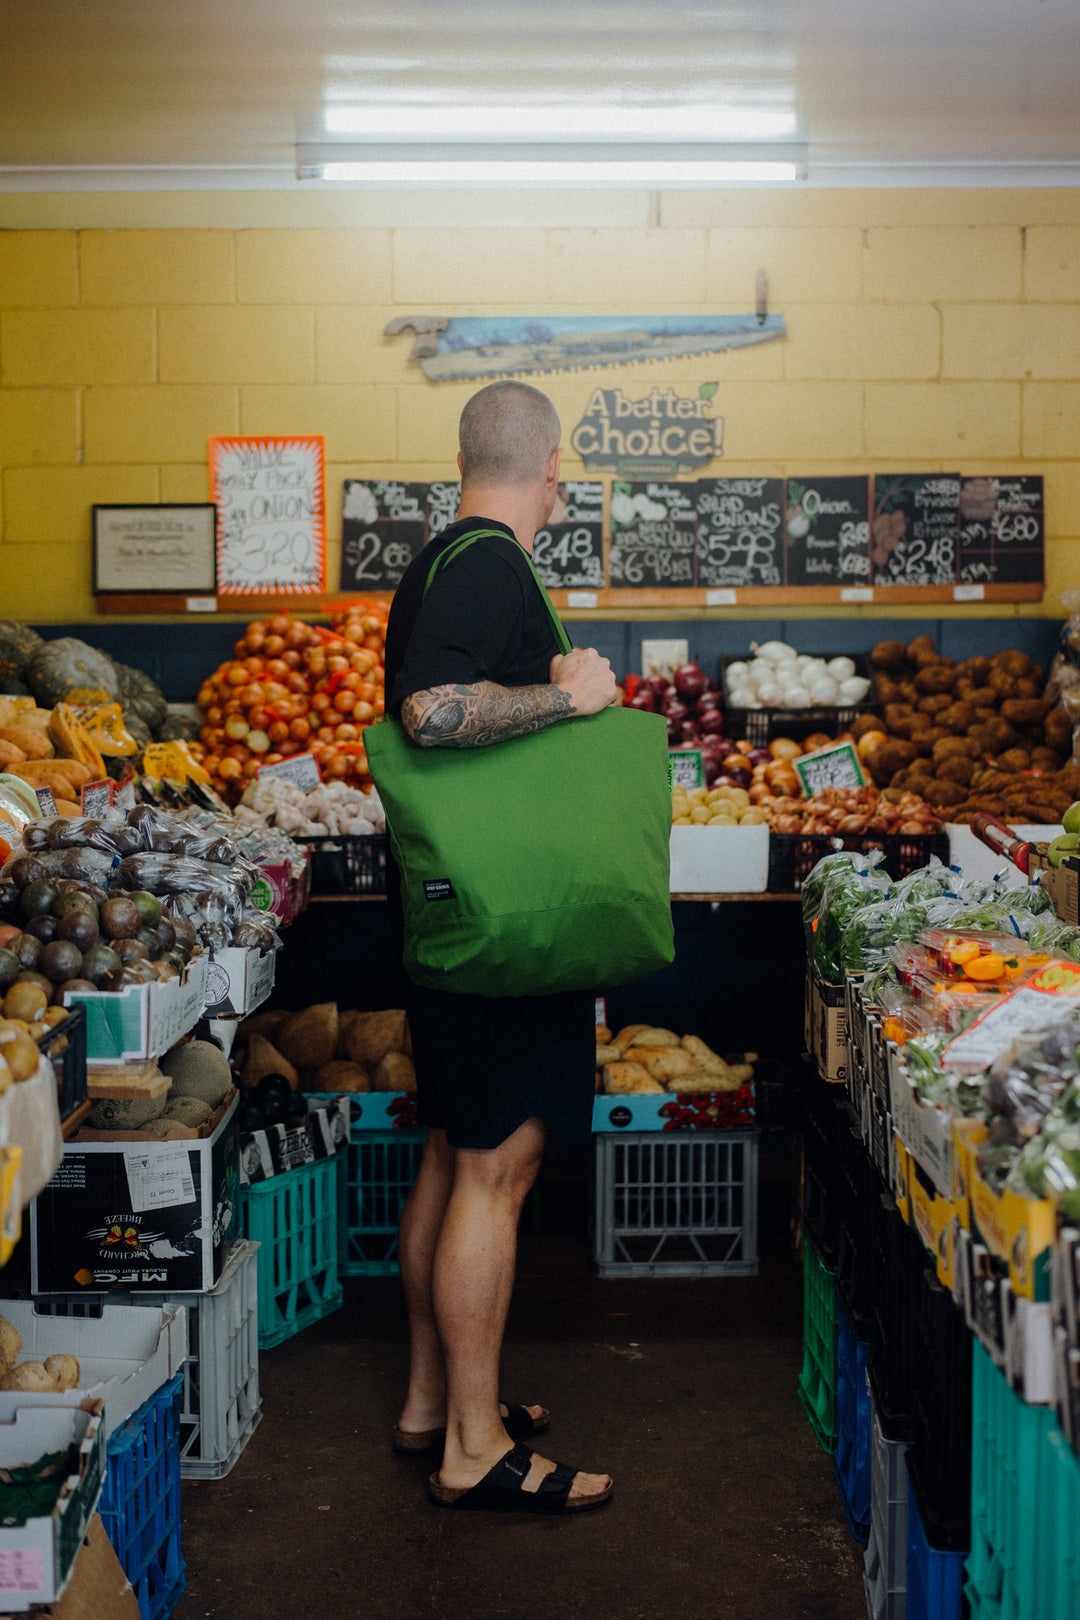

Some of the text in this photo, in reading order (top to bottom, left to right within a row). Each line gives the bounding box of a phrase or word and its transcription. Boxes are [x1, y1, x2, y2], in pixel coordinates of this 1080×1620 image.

[586, 387, 712, 419] A better
[572, 417, 725, 457] choice!
[104, 1214, 143, 1226] BREEZE
[94, 1273, 168, 1283] MFC
